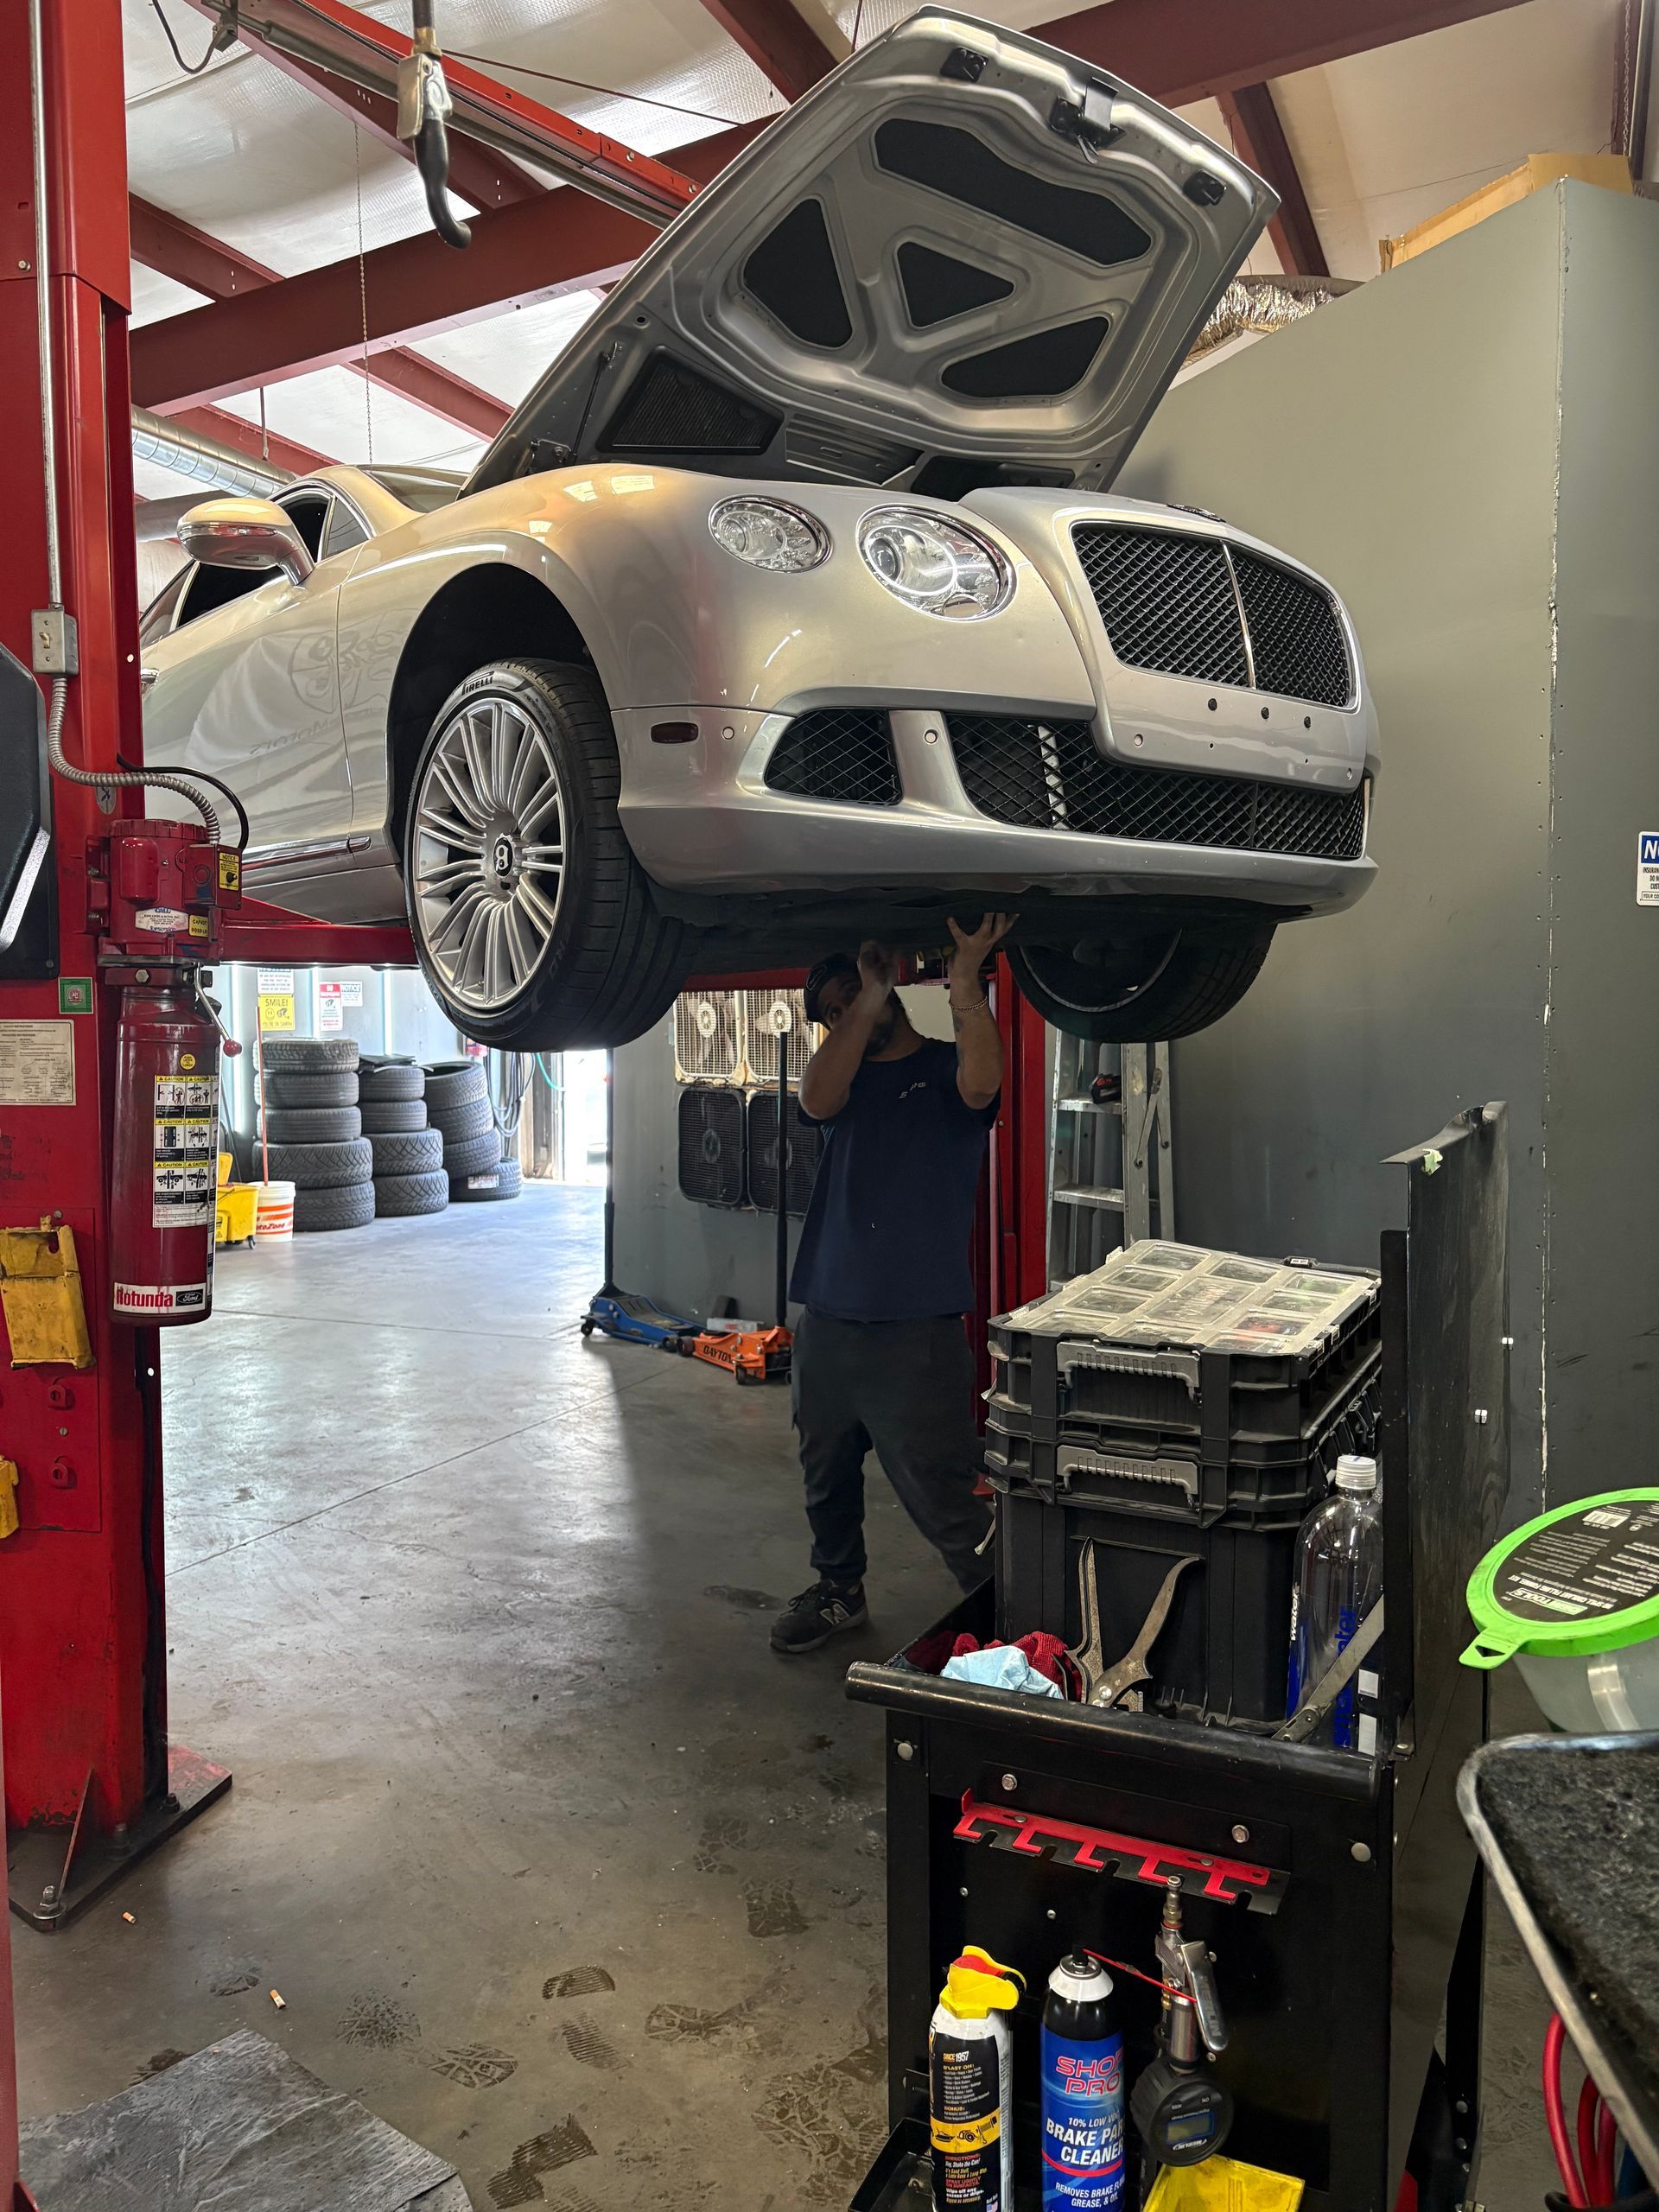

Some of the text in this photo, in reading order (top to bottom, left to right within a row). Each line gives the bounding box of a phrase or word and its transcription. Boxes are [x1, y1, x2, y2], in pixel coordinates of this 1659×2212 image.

[461, 671, 494, 696] PIRELLI
[265, 998, 288, 1007] SMILE!
[116, 1287, 174, 1307] Rotunda
[702, 1344, 734, 1364] DAYTON
[1290, 1583, 1300, 1641] water
[955, 2050, 969, 2063] 1957
[1065, 2071, 1121, 2097] PRO
[1068, 2117, 1087, 2127] 10%
[1089, 2116, 1107, 2127] LOW
[1046, 2118, 1122, 2146] BRAKE PAR
[1060, 2137, 1123, 2165] CLEANER
[1055, 2182, 1089, 2198] REMOVES
[1090, 2183, 1114, 2198] BRAKE
[1071, 2192, 1118, 2208] GREASE, & OIL
